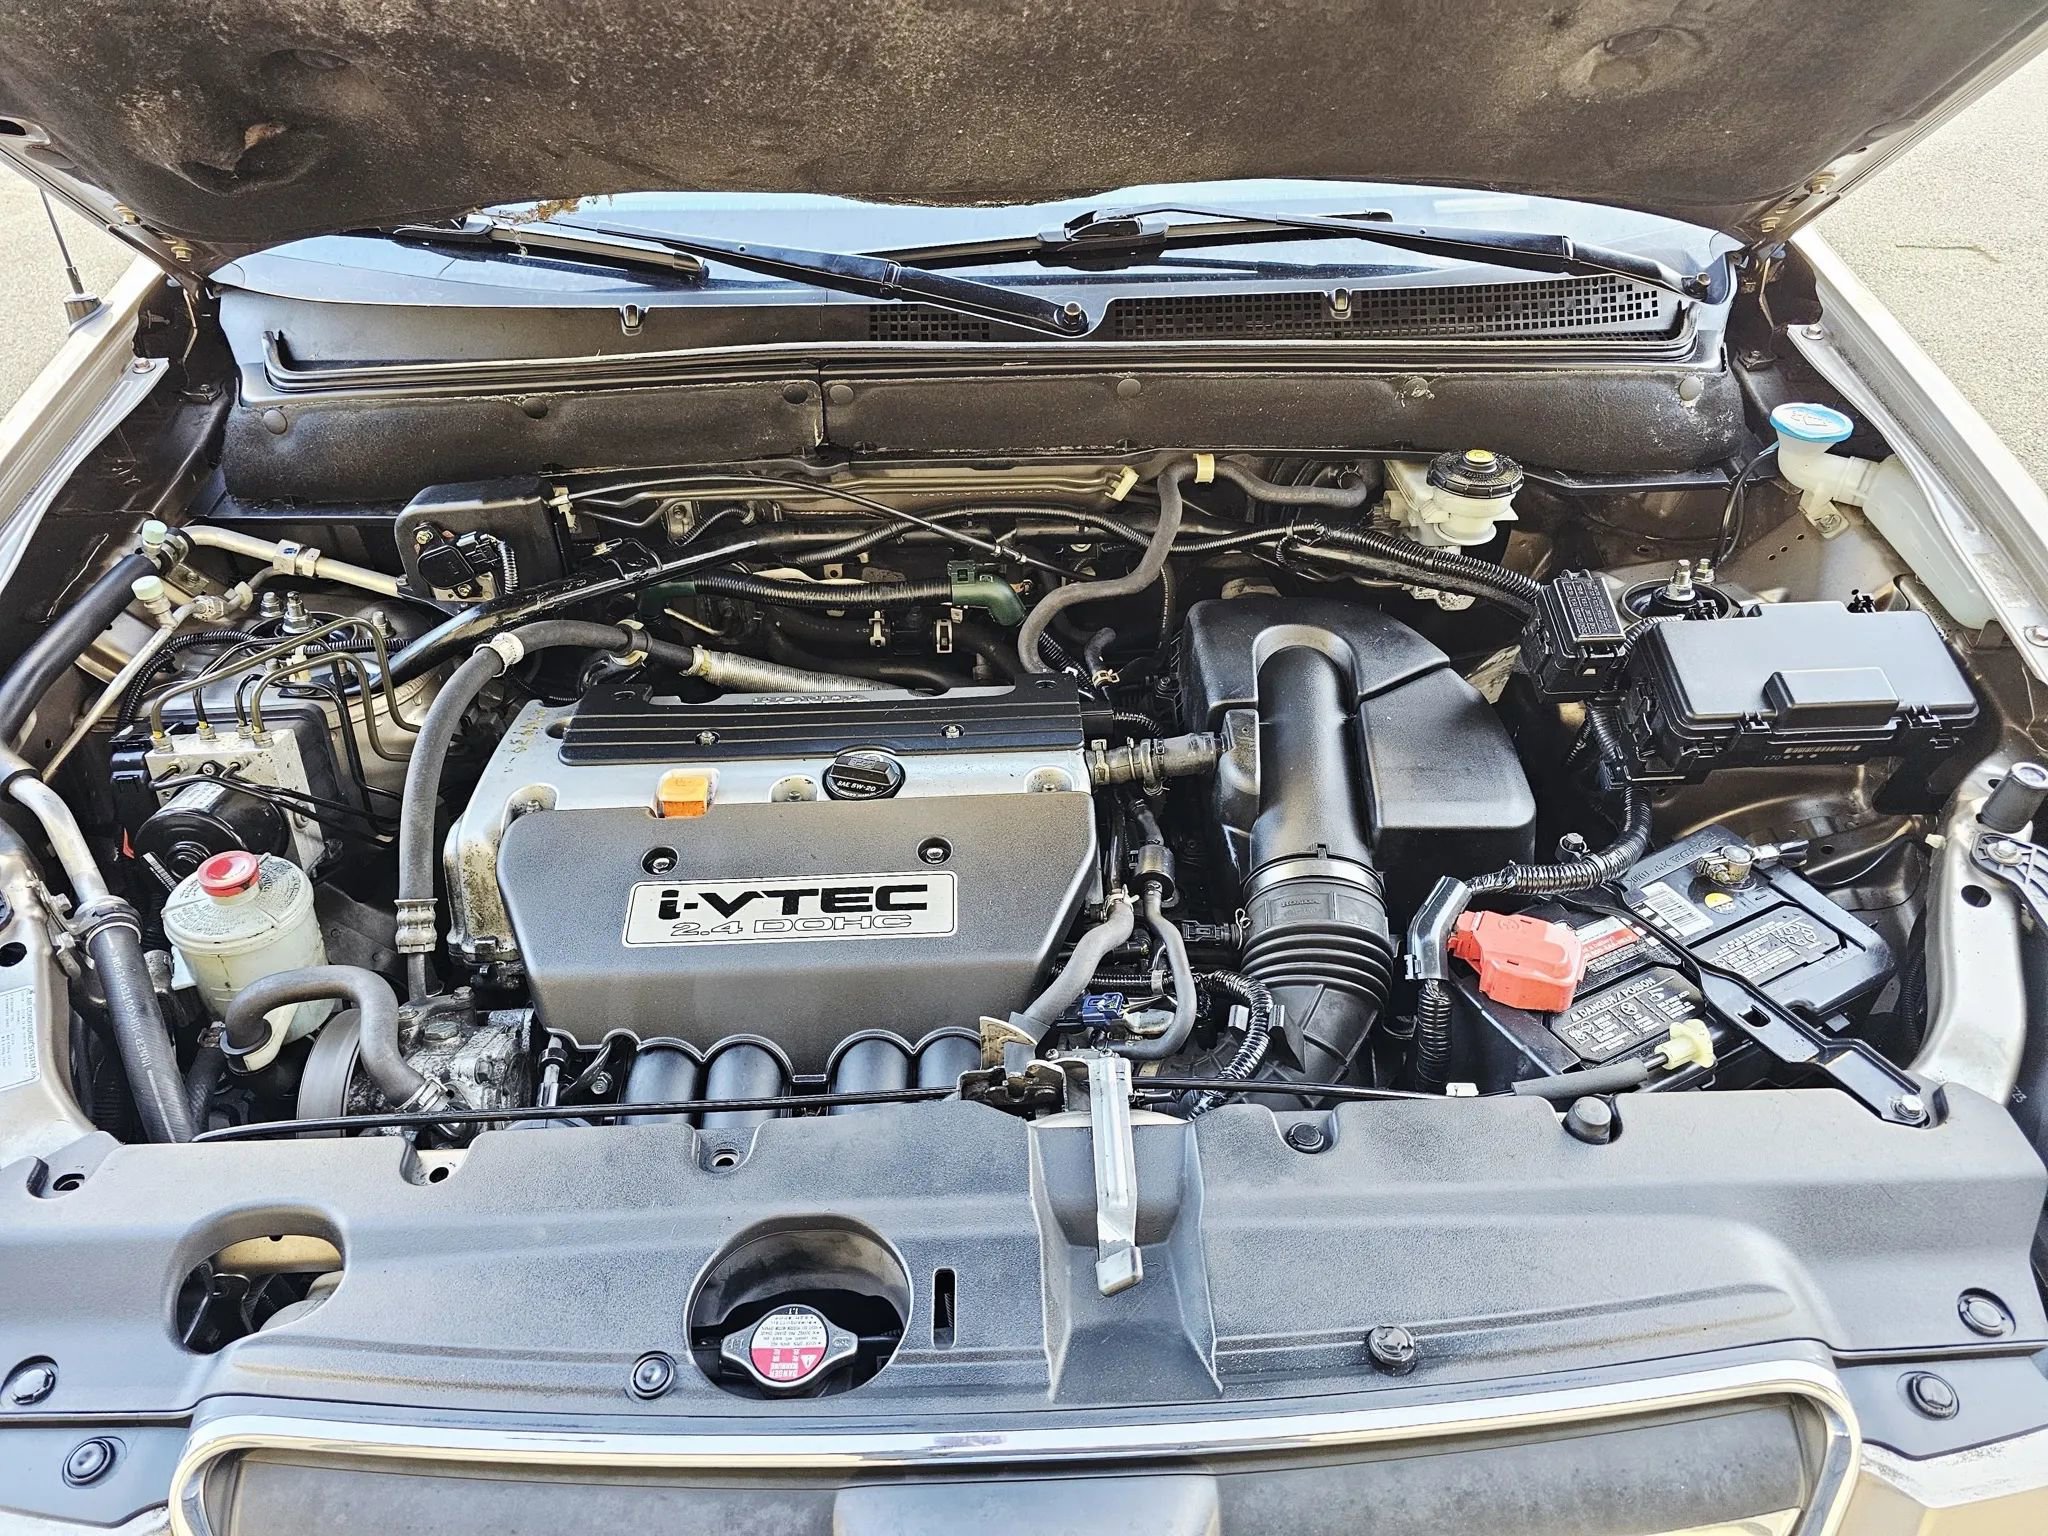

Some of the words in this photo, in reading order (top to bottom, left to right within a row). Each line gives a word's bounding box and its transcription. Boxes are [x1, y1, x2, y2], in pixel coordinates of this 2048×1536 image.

[657, 884, 928, 920] i-VTEC
[670, 920, 743, 936] 2.4
[753, 913, 912, 933] DOHC
[1577, 993, 1615, 1018] DANGER
[1620, 977, 1656, 997] POISON
